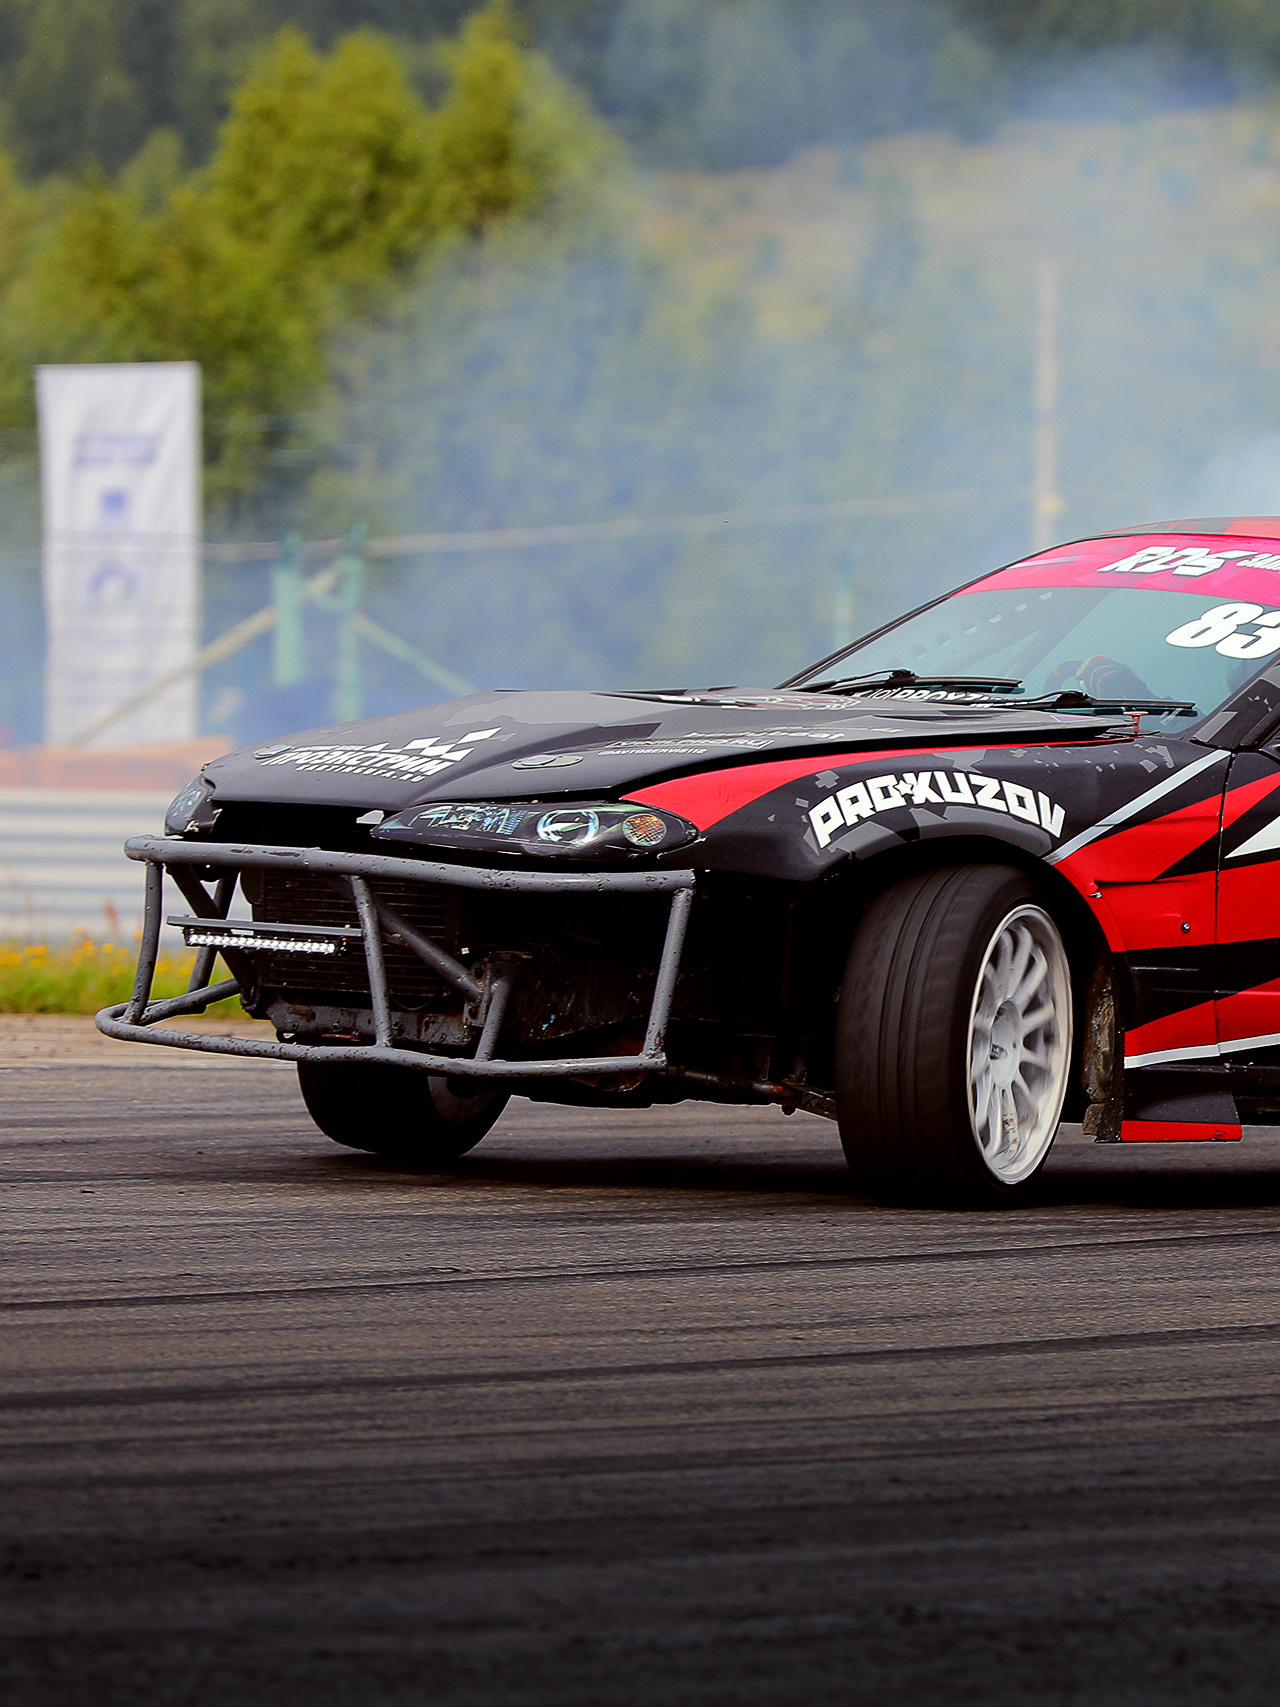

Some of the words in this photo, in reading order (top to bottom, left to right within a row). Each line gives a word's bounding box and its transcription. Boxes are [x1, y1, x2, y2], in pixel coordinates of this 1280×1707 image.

[1097, 546, 1258, 577] RDS
[260, 750, 455, 776] ПРОЭКСТРИМ
[295, 764, 426, 782] KARTINGUFA.RU
